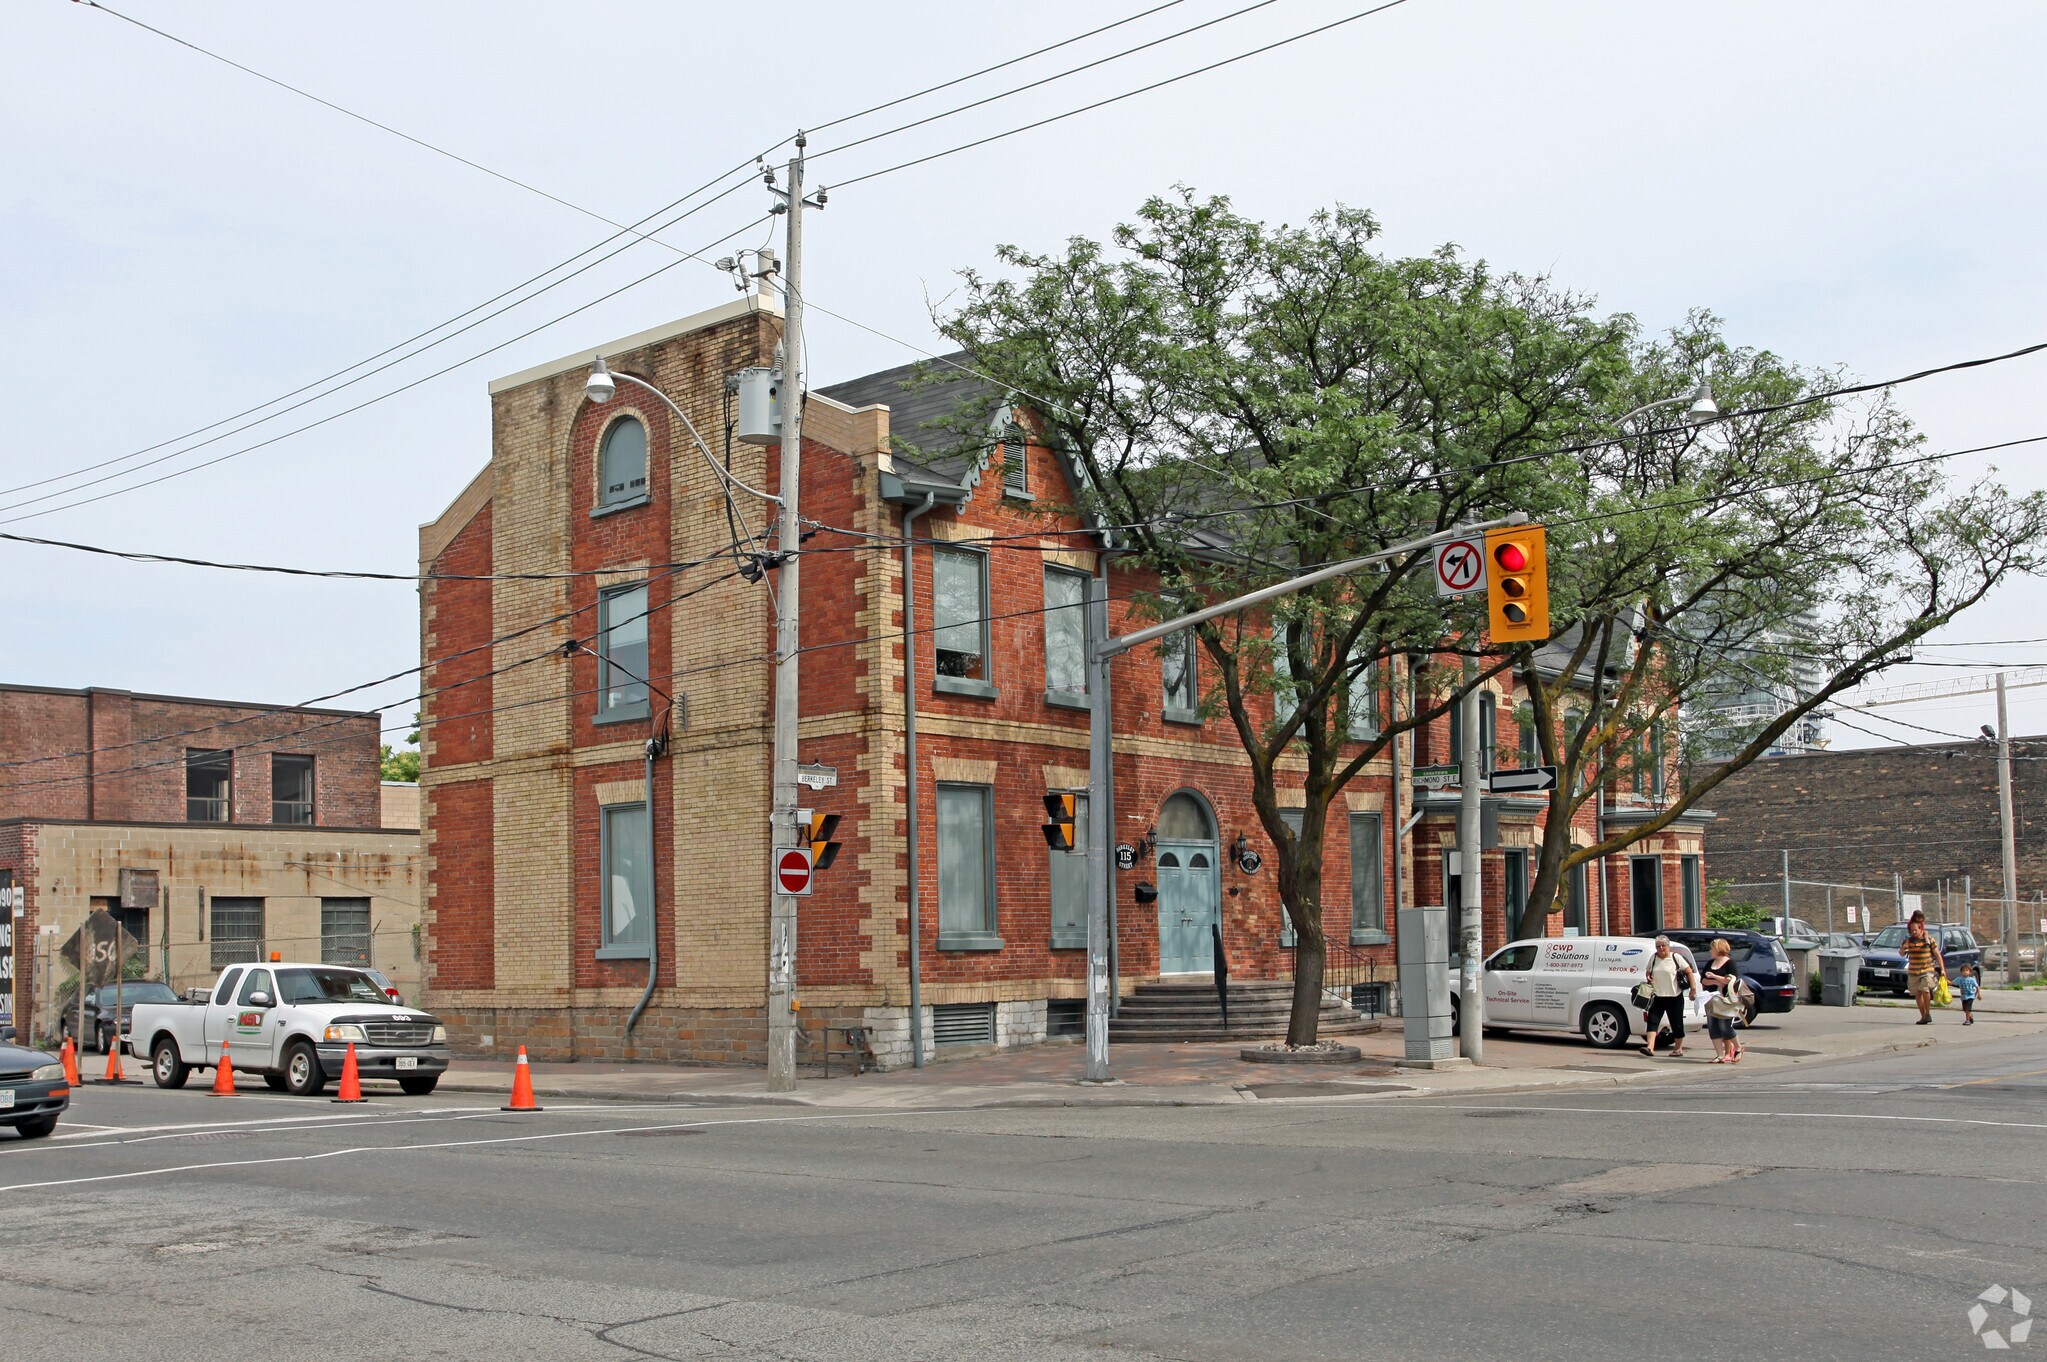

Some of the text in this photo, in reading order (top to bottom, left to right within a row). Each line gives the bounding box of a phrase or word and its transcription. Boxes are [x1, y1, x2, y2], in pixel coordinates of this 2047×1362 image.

[801, 775, 824, 784] BERKELEY
[1413, 776, 1440, 784] RICHMOND
[1115, 844, 1135, 853] BERKELEY
[1120, 851, 1132, 861] 115
[1118, 861, 1133, 869] STREET
[1552, 944, 1573, 953] cwp
[1550, 952, 1590, 960] Solutions
